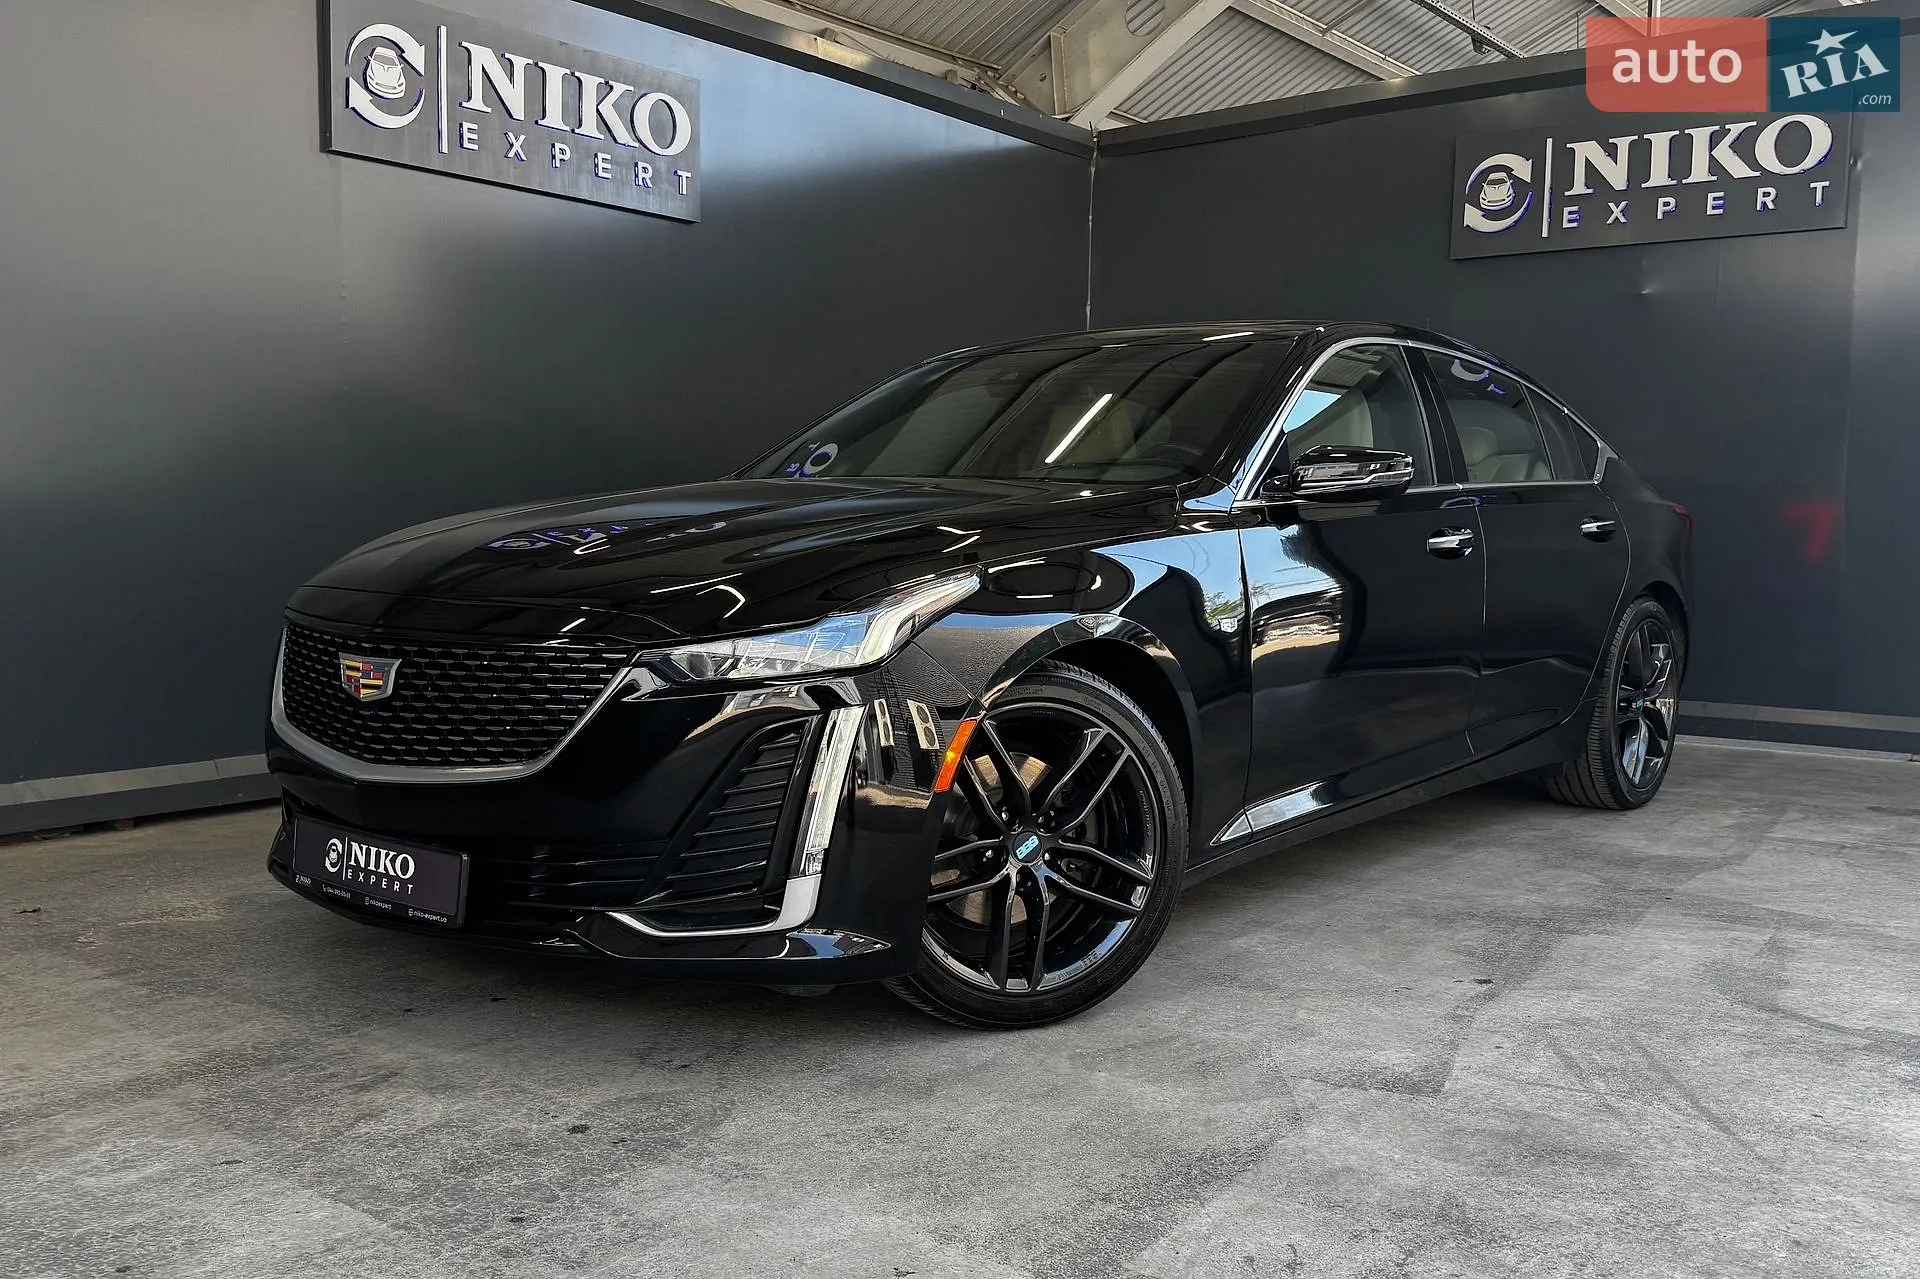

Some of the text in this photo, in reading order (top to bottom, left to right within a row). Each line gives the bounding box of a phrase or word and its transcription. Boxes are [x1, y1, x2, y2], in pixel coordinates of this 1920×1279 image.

[459, 40, 692, 156] NIKO
[459, 121, 692, 195] EXPERT
[1564, 114, 1833, 198] NIKO
[1563, 181, 1830, 229] EXPERT
[347, 869, 413, 895] EXPERT
[348, 841, 415, 879] NIKO
